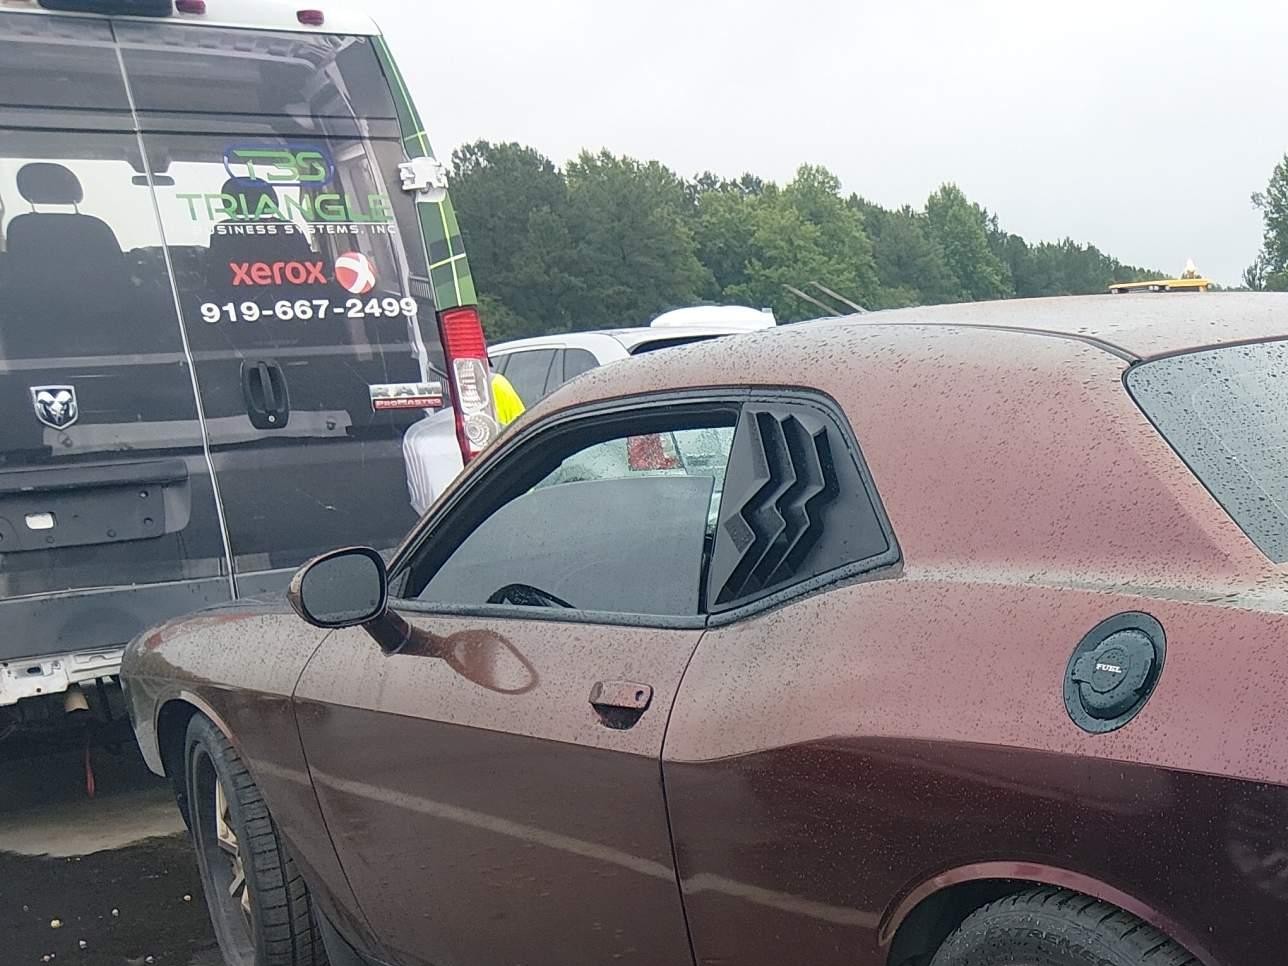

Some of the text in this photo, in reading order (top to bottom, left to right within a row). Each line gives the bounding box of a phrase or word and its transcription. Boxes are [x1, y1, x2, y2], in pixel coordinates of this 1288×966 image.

[176, 192, 394, 222] TRIANGLE
[229, 261, 327, 286] xerox
[201, 298, 419, 324] 919-667-2499
[1095, 662, 1122, 674] FUEL
